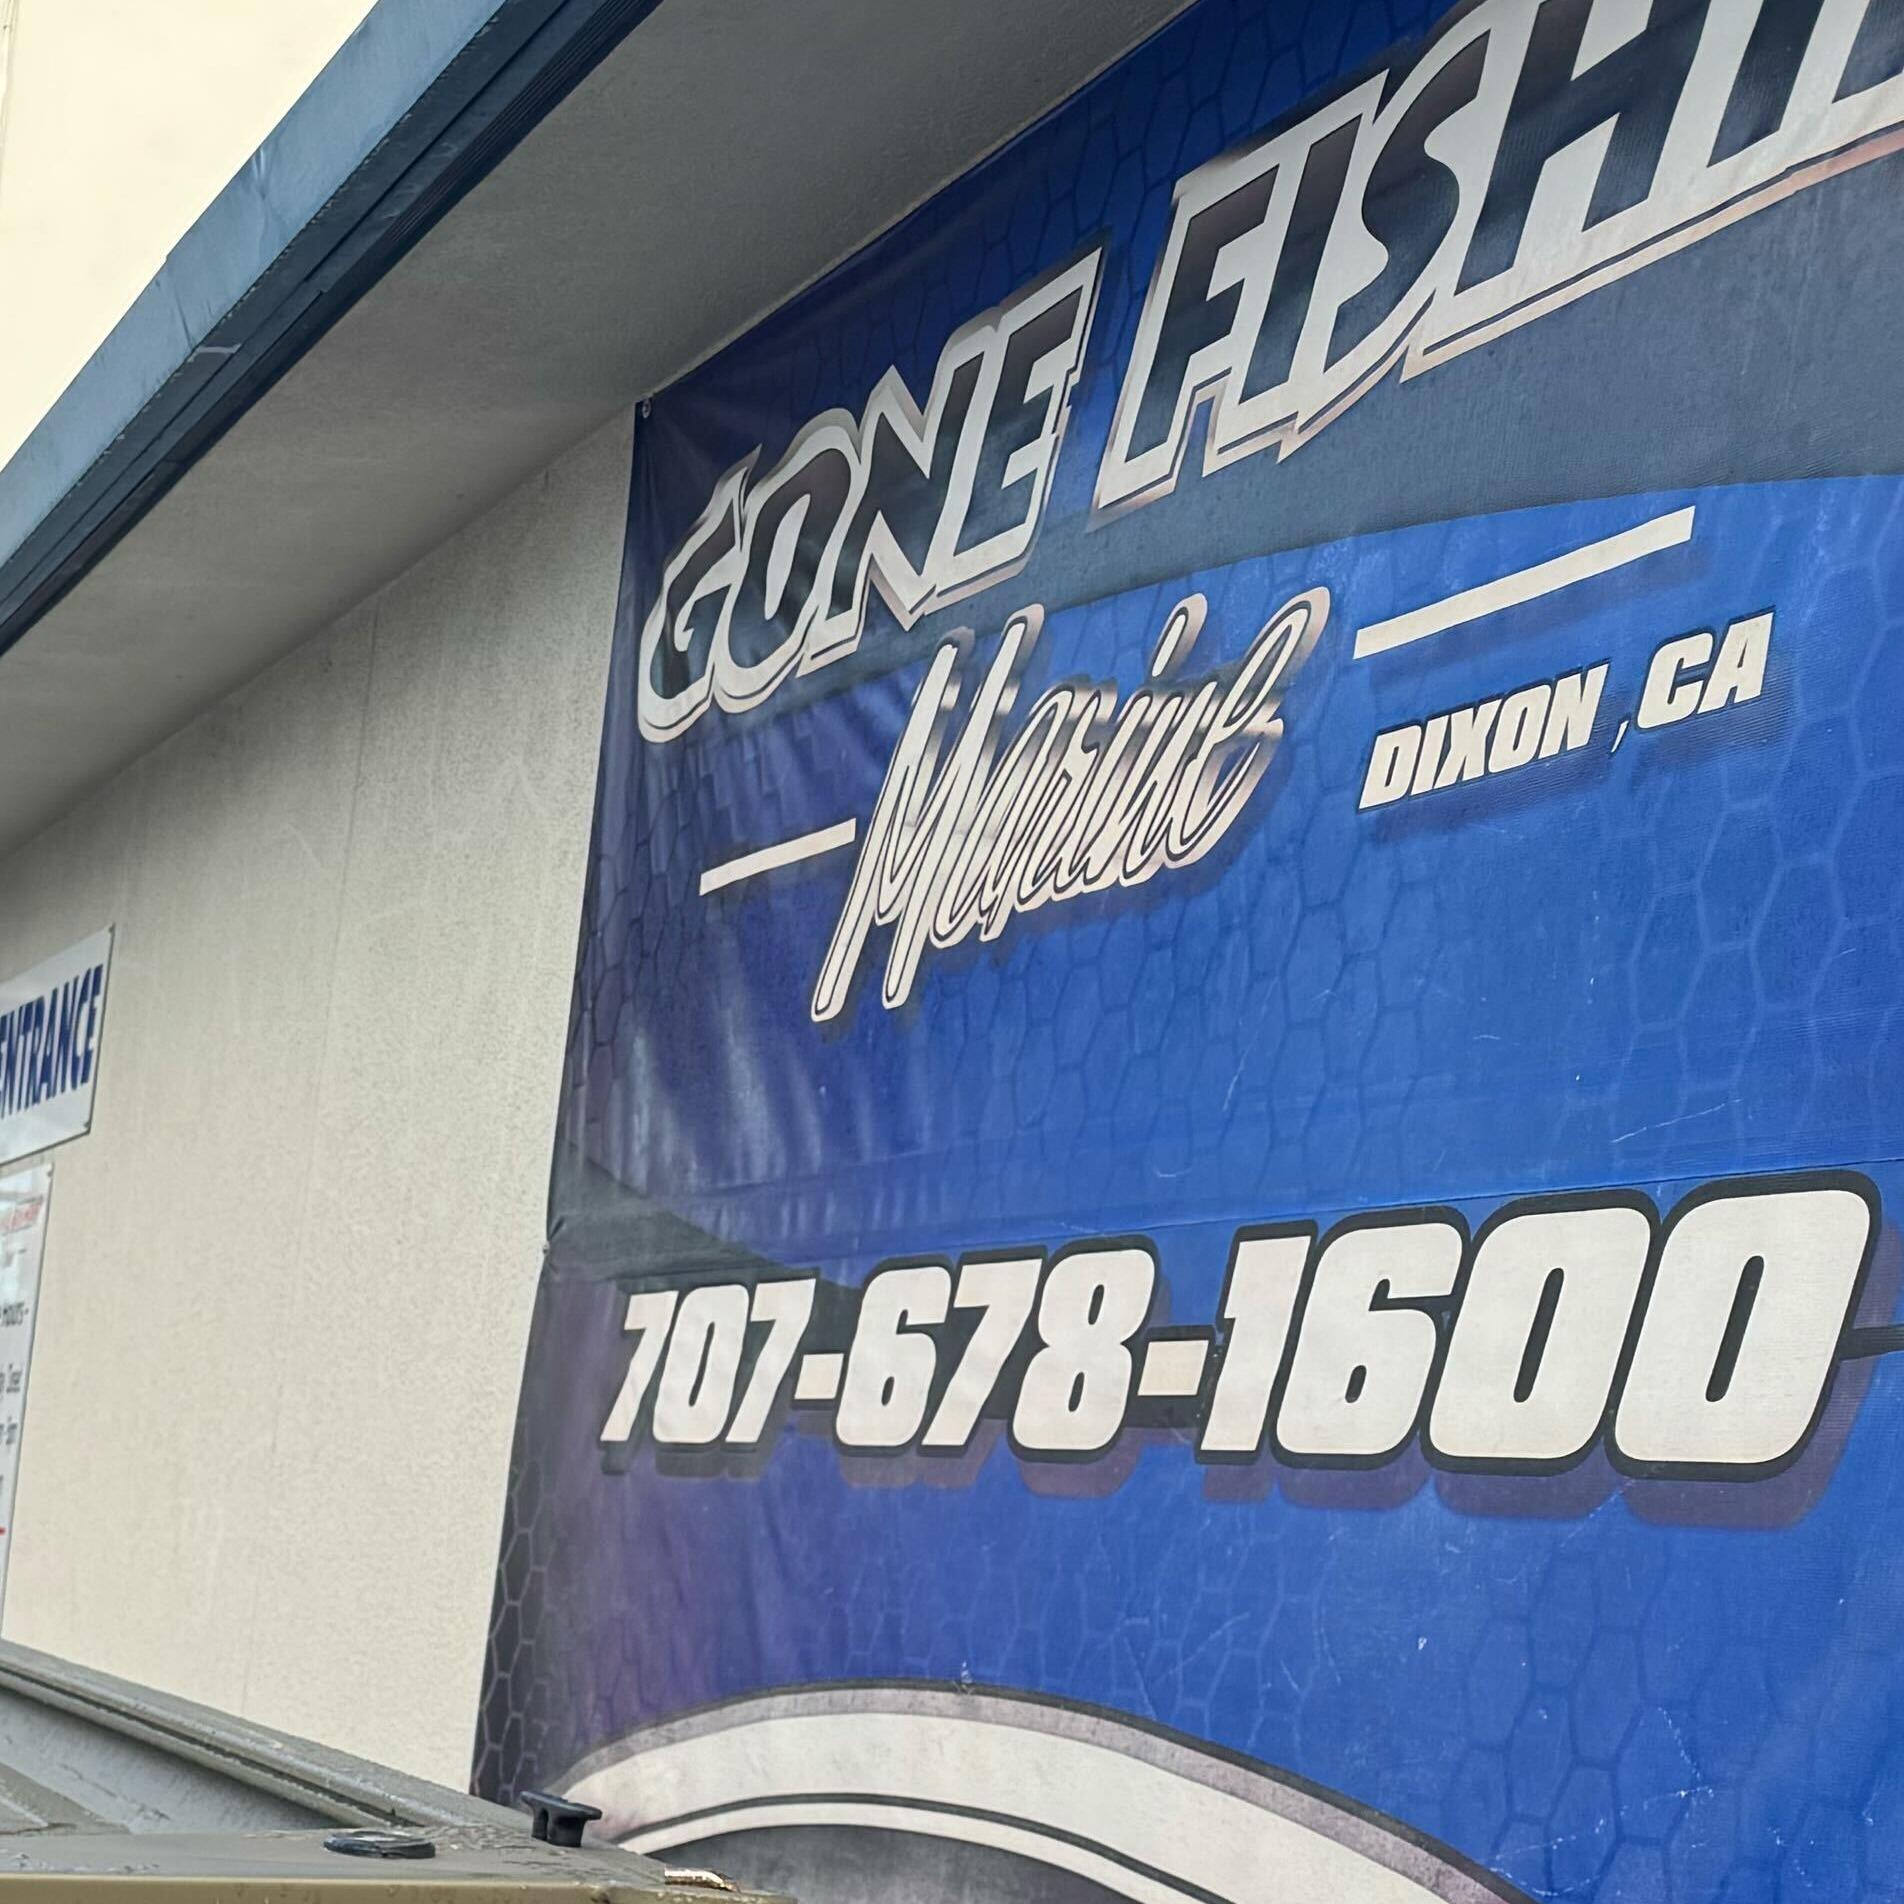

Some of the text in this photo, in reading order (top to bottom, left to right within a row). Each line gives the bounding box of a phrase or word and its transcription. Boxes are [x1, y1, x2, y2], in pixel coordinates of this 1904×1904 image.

[638, 243, 1106, 742] GONE
[810, 586, 1332, 1023] Marine
[599, 1185, 1873, 1466] 707-678-1600
